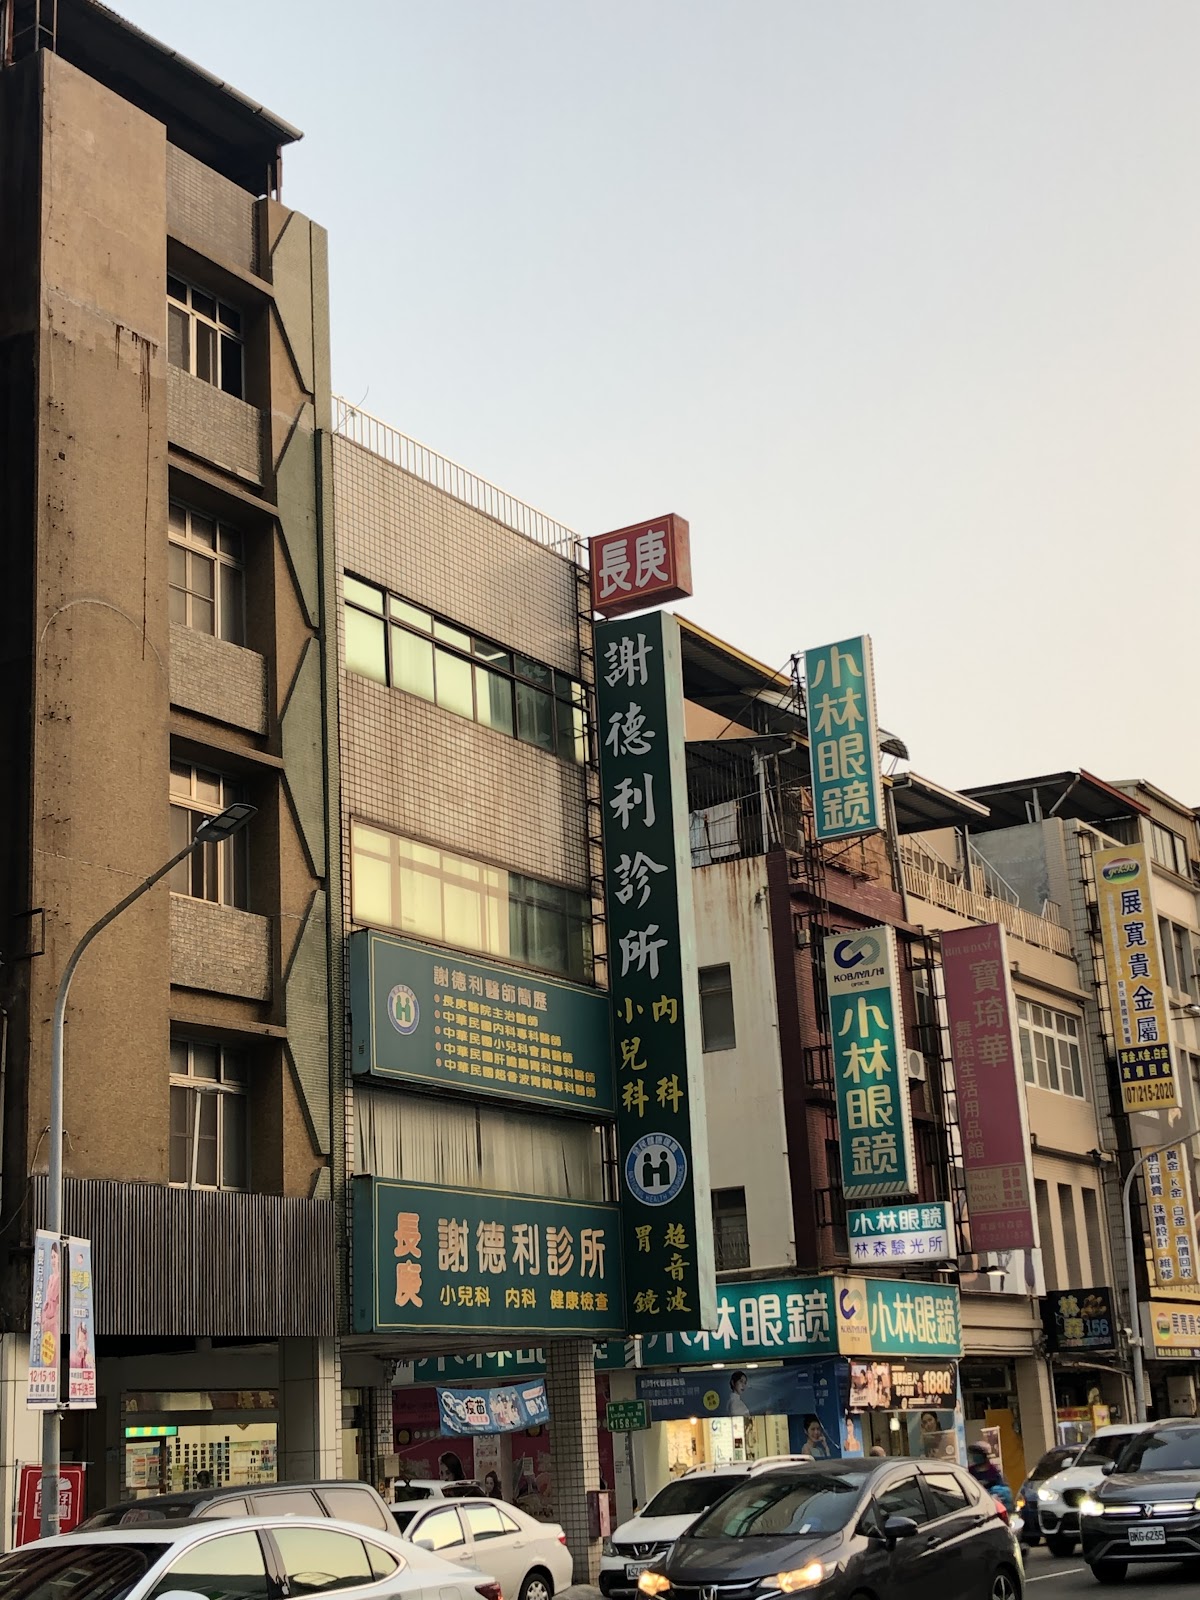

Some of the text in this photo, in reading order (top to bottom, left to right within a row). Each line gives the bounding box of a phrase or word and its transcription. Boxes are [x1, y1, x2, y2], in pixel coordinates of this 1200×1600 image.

[599, 529, 668, 598] 長庚
[810, 645, 870, 831] 小林眼鏡
[603, 632, 668, 980] 謝德利診所
[433, 965, 548, 1011] 謝德利醫師簡歷
[833, 967, 885, 982] KOBAYASHI
[1120, 889, 1159, 1043] 展寬貴金屬
[442, 994, 539, 1027] 長庚醫院主治醫師
[969, 958, 1009, 1068] 寶琦華
[617, 996, 649, 1118] 小兒科
[838, 996, 898, 1176] 小林眼鏡
[955, 1020, 985, 1159] 舞蹈生活用品館
[437, 1217, 607, 1280] 謝德利診所
[853, 1207, 942, 1234] 小林眼鏡
[854, 1236, 943, 1258] 林森驗光所
[394, 1211, 423, 1308] 長庚
[633, 1224, 660, 1315] 胃鏡
[663, 1222, 692, 1312] 超音波
[440, 1284, 609, 1312] 小兒科 內科 健康檢查
[871, 1290, 957, 1346] 小林眼鏡
[1086, 1319, 1109, 1336] 156
[464, 1398, 486, 1415] 疫苗
[923, 1370, 951, 1394] 1880
